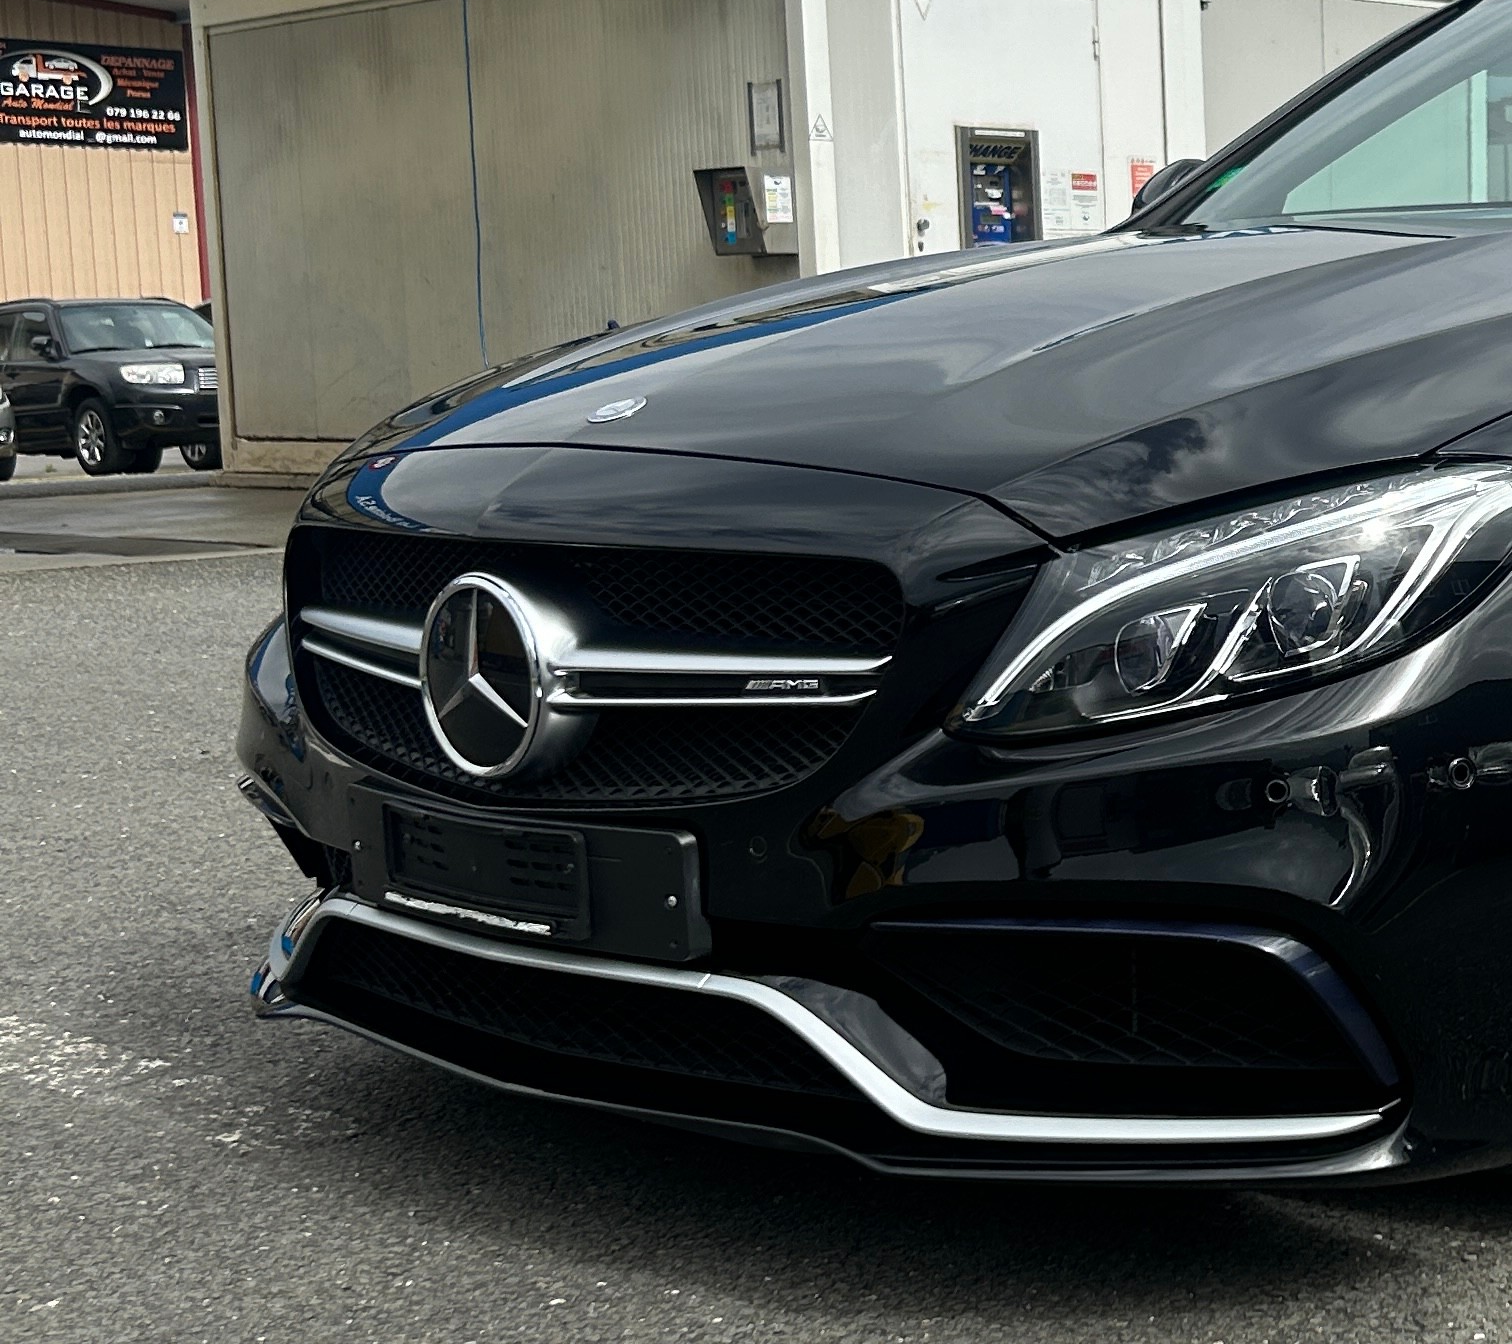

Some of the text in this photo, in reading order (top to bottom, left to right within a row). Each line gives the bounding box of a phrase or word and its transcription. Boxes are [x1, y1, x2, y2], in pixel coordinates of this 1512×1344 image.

[0, 82, 89, 101] GARAGE
[61, 116, 100, 129] toutes
[103, 117, 120, 130] les
[123, 119, 176, 133] marques
[969, 143, 1022, 159] HANGE
